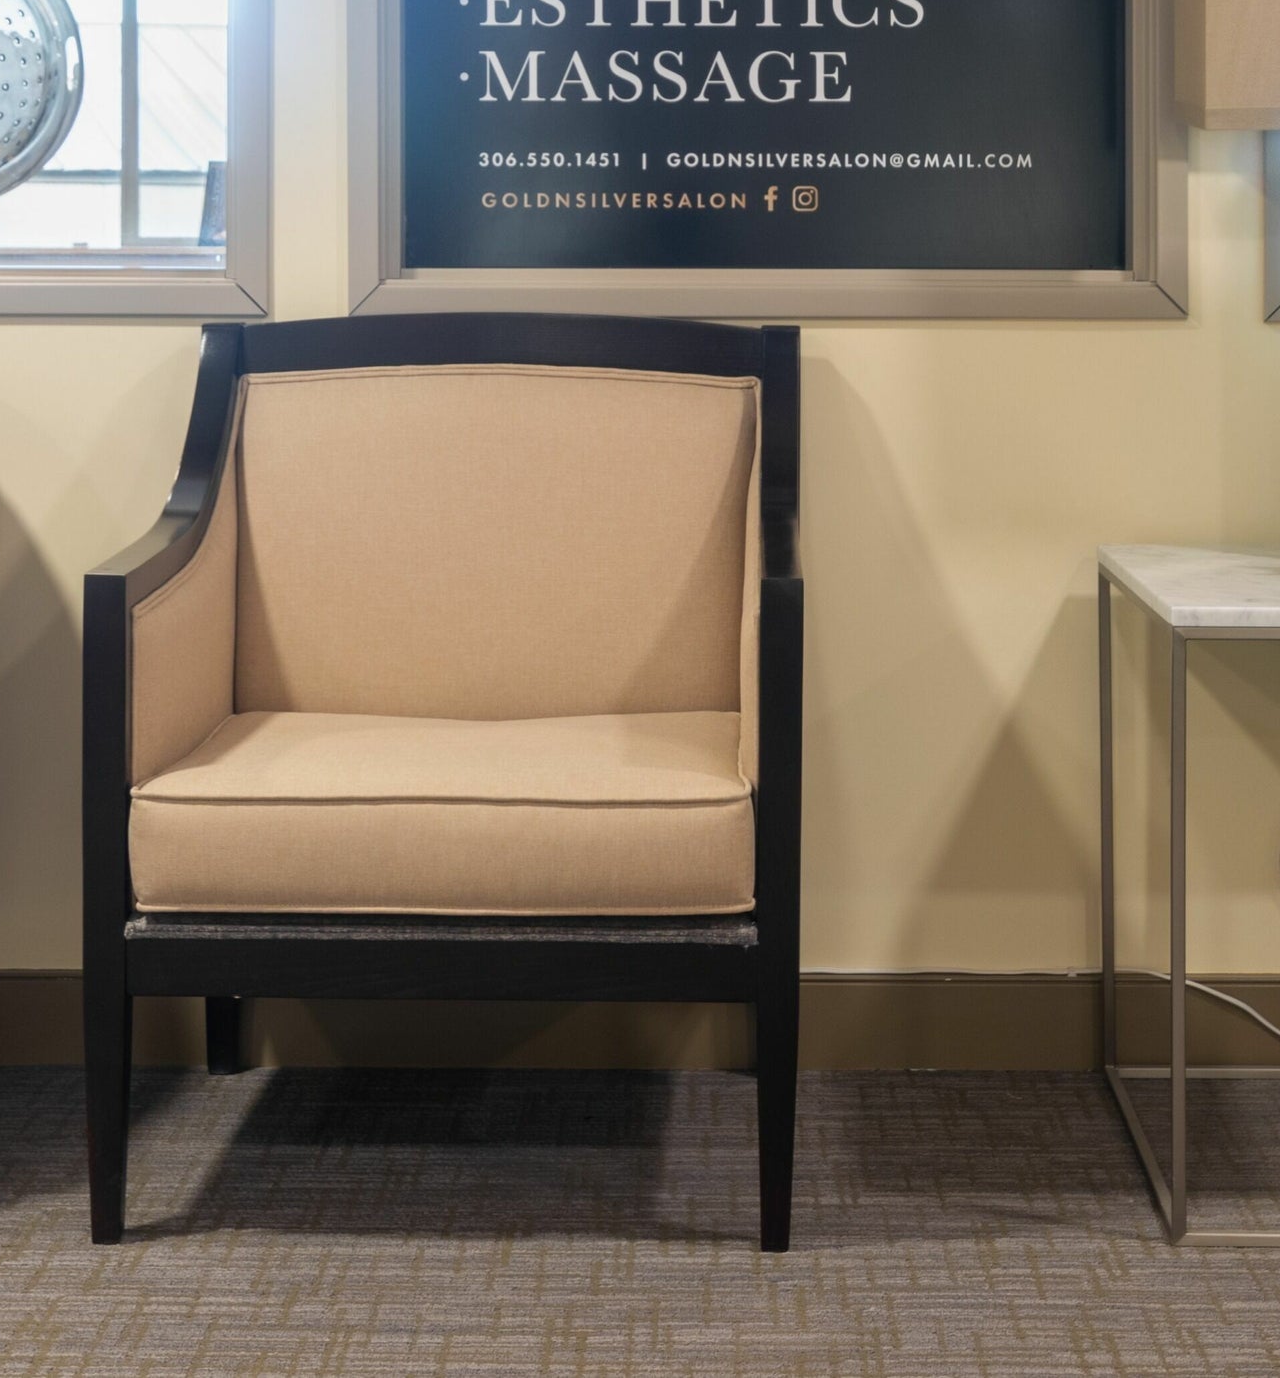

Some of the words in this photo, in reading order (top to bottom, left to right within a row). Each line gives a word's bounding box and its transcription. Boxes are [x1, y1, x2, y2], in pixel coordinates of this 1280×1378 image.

[478, 49, 853, 103] MASSAGE
[478, 152, 620, 168] 306.550.1451
[666, 152, 1033, 169] GOLDNSILVERSALON@GMAIL.COM
[481, 192, 747, 209] GOLDNSILVERSALON
